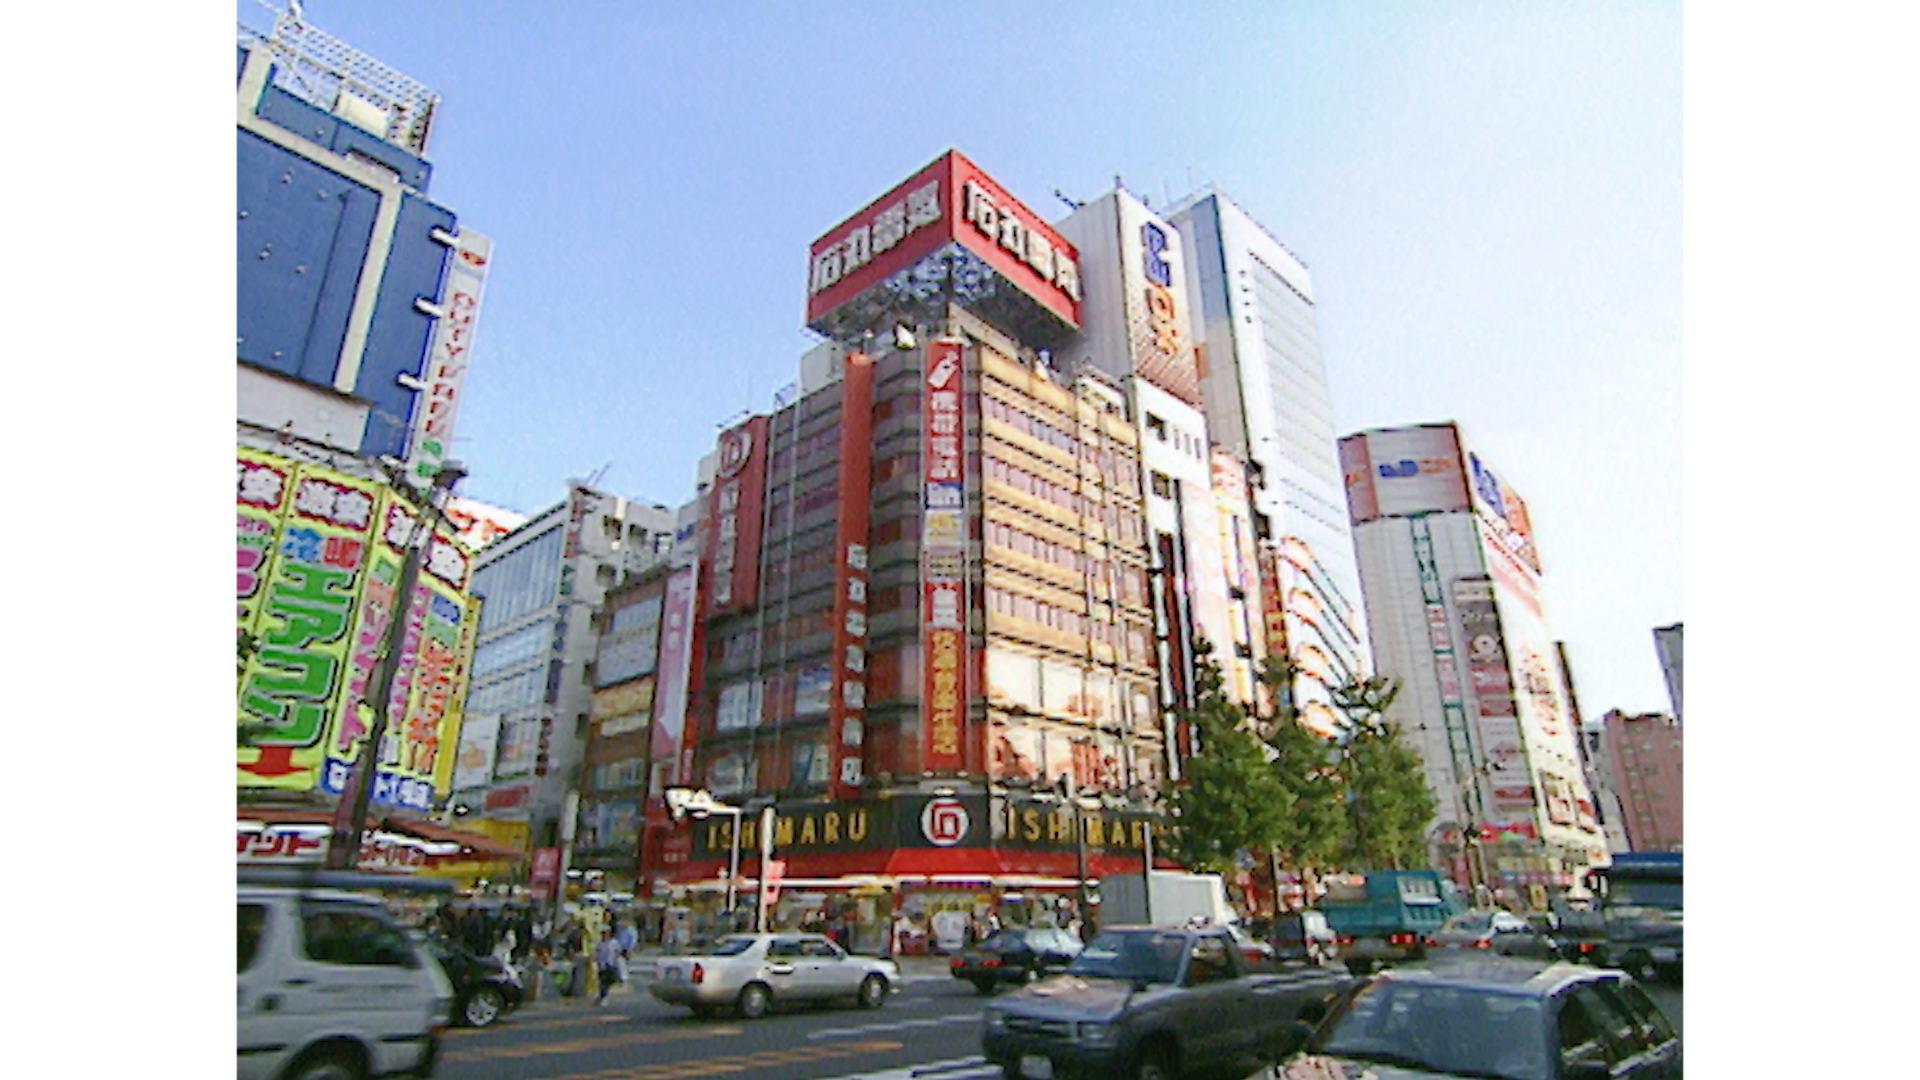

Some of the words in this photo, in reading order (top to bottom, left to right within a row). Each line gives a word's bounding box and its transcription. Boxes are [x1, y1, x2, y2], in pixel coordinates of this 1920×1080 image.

[242, 560, 357, 746] エアコン
[707, 808, 868, 850] ISHMARU
